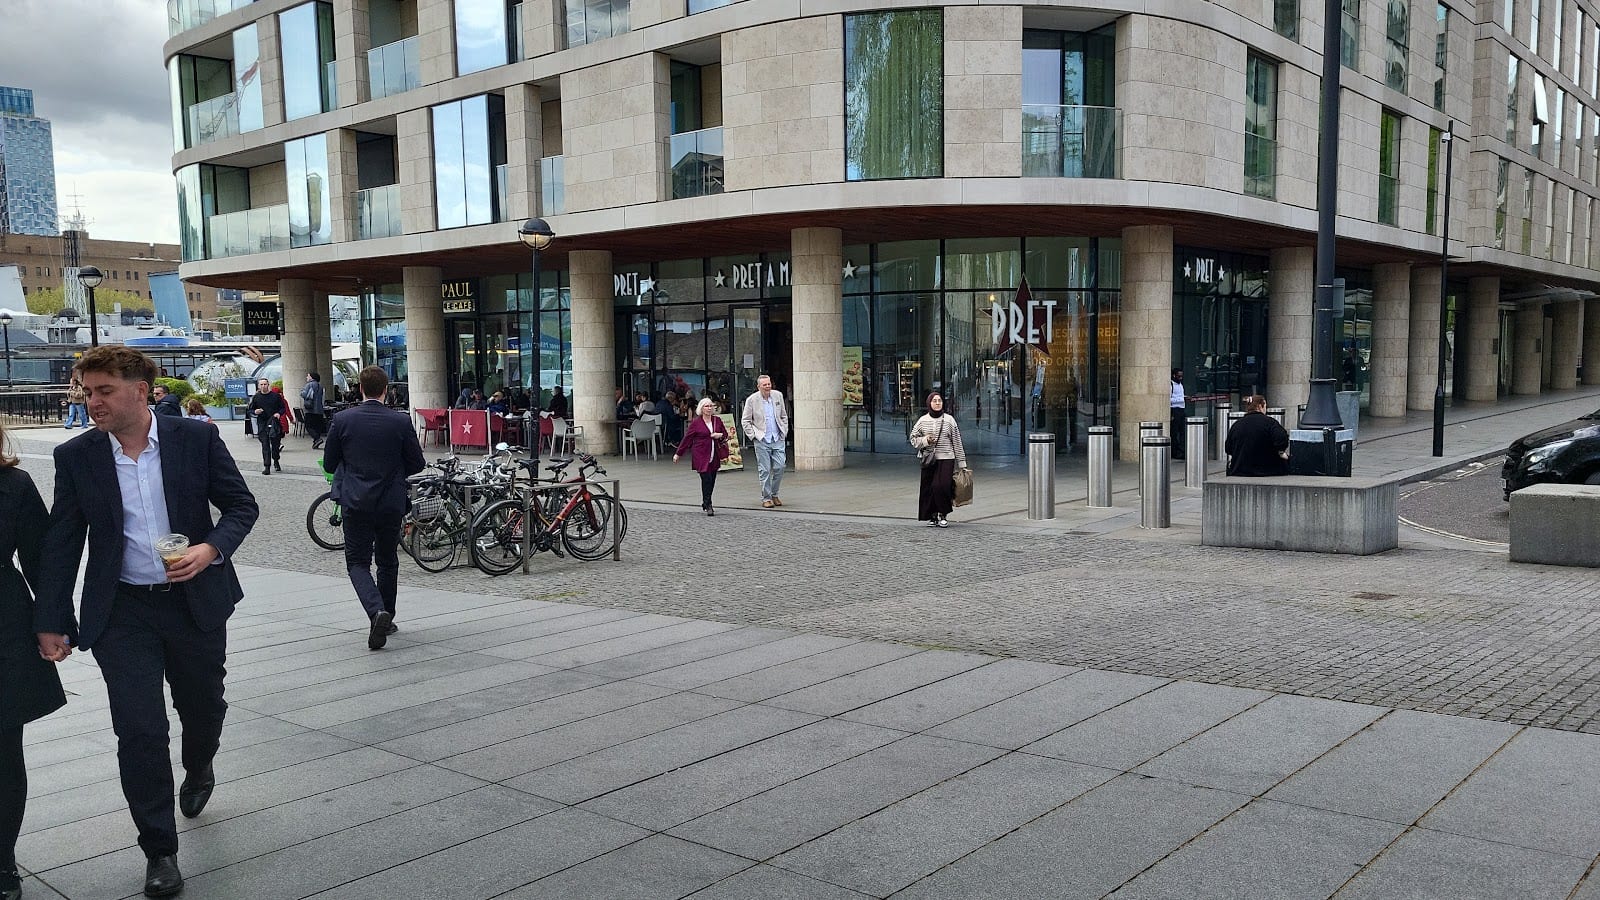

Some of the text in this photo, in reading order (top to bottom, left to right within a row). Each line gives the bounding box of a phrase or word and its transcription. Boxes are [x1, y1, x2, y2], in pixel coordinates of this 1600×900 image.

[732, 260, 792, 289] PRET A M
[1195, 257, 1215, 283] PRET
[441, 282, 474, 298] PAUL
[613, 272, 638, 296] PRET
[248, 310, 274, 319] PAUL
[991, 300, 1057, 344] PRET
